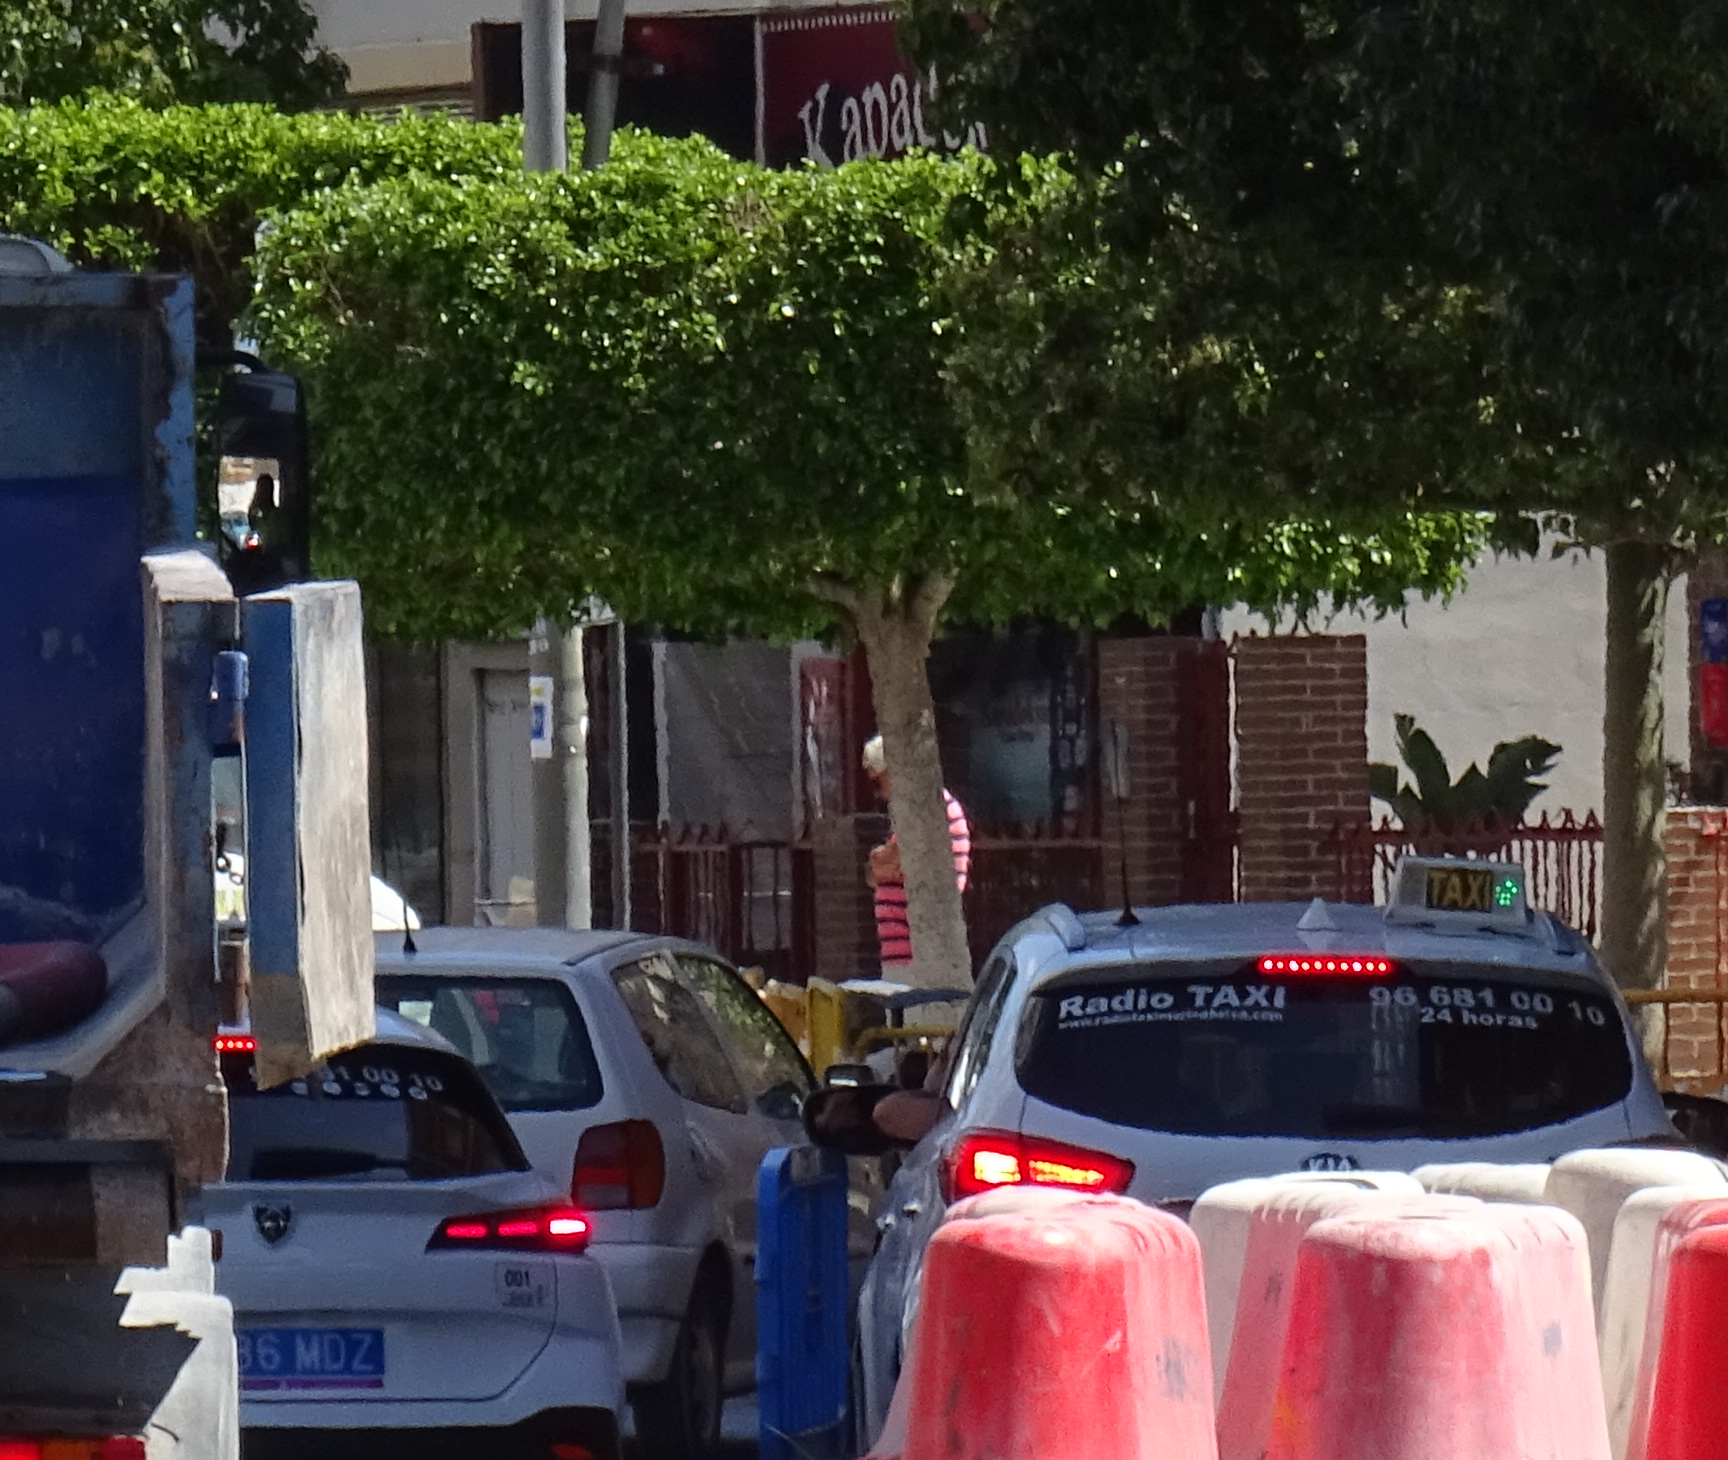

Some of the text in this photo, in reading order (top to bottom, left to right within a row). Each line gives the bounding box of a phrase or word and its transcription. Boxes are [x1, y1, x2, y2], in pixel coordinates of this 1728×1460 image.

[1429, 869, 1491, 910] TAXI
[1059, 984, 1605, 1027] Radio TAXI 96 681 00 10
[1421, 1006, 1538, 1030] 24 horas
[362, 1065, 399, 1084] 00
[410, 1072, 444, 1092] 10
[295, 1331, 373, 1371] MDZ
